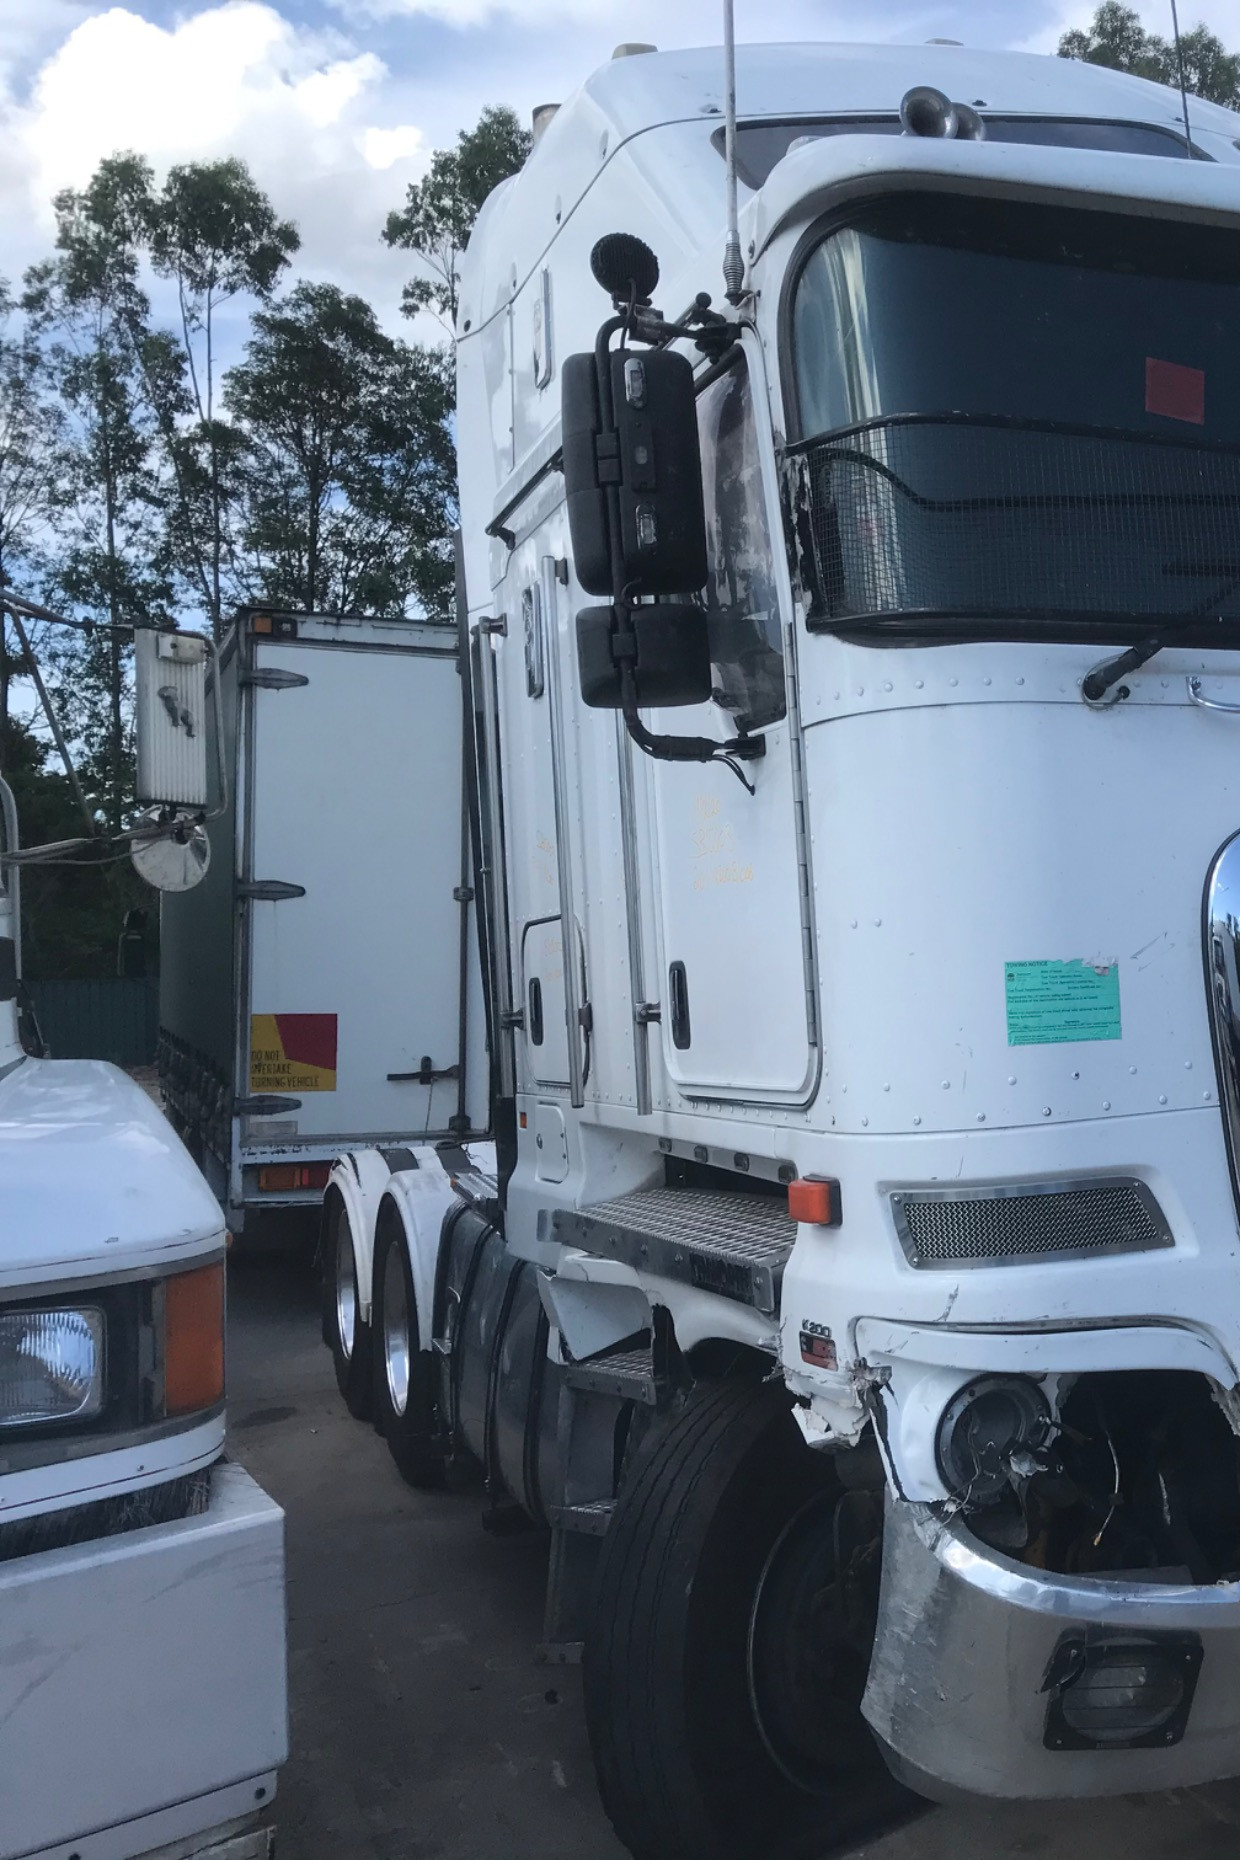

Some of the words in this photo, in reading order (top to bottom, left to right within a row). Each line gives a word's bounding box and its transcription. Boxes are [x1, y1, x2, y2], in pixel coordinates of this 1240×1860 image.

[251, 1051, 262, 1061] DO
[264, 1050, 280, 1061] NOT
[251, 1076, 286, 1089] TURNING
[287, 1075, 320, 1088] VEHICLE
